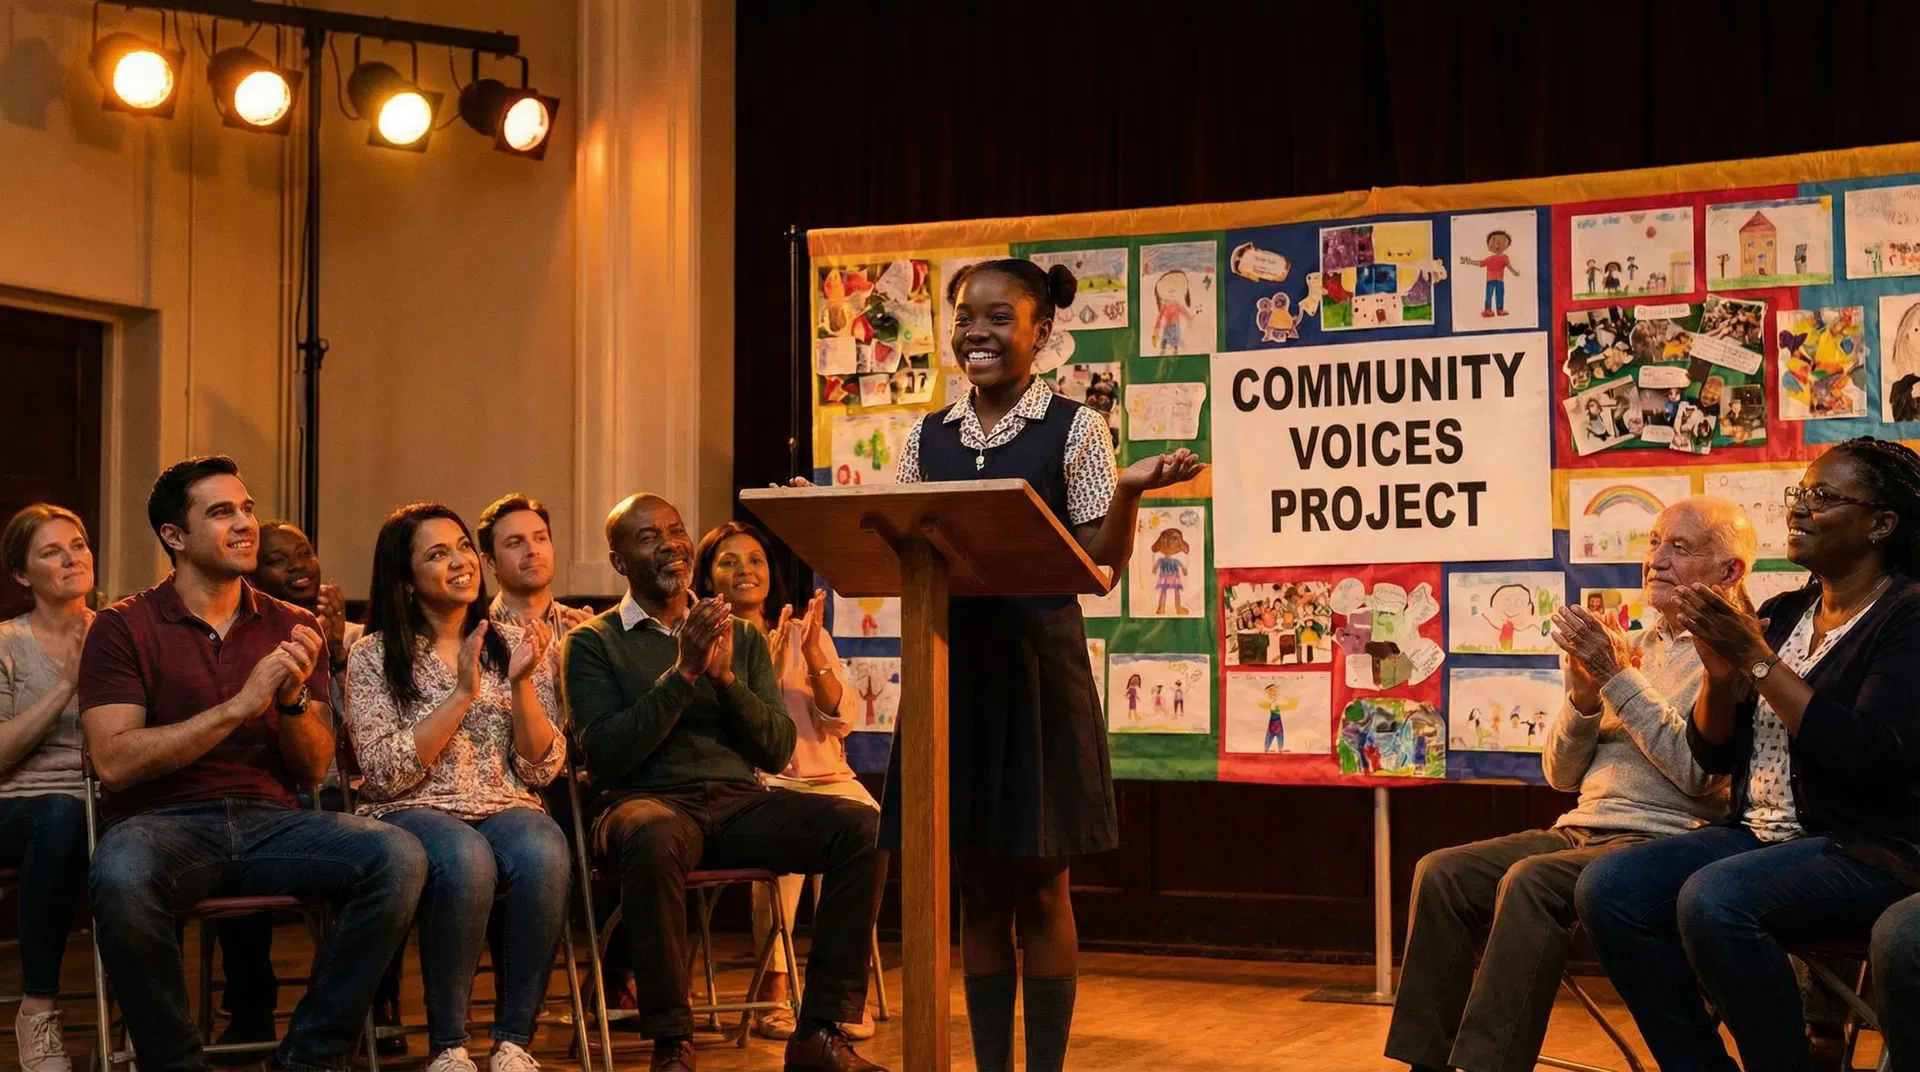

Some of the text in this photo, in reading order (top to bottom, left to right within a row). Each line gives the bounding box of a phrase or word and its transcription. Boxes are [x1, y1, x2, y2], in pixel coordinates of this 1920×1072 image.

[1233, 351, 1526, 413] COMMUNITY
[1288, 419, 1464, 469] VOICES
[1272, 481, 1487, 534] PROJECT
